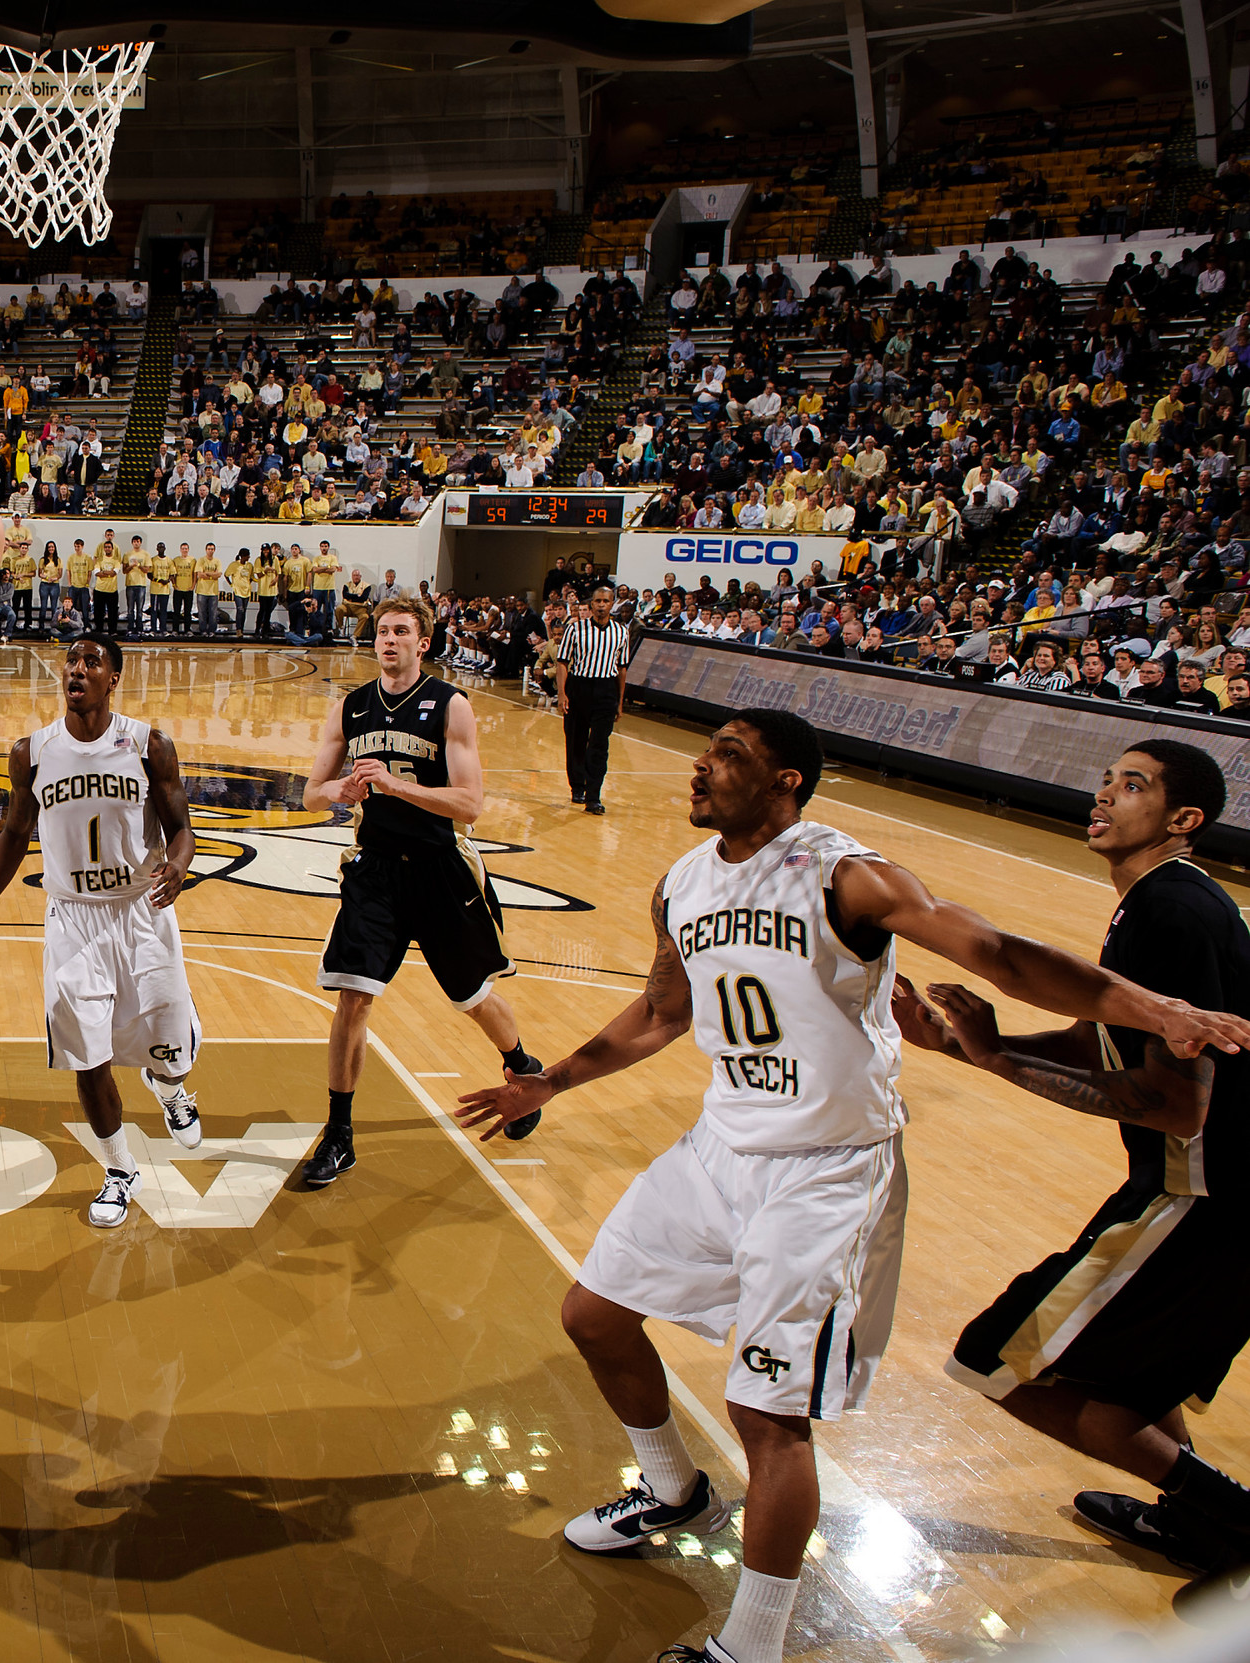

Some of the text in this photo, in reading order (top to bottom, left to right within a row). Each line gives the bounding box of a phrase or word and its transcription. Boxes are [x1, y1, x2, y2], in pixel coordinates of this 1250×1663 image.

[487, 508, 506, 522] 59
[528, 497, 568, 512] 12:34
[550, 512, 558, 523] 2
[586, 509, 607, 524] 29
[665, 538, 799, 565] GEICO
[961, 665, 975, 677] POSS
[726, 663, 797, 711] Iman
[797, 674, 962, 751] Shumpert
[348, 730, 438, 762] WAKE FOREST
[41, 773, 140, 811] GEORGIA
[88, 813, 101, 864] 1
[70, 865, 132, 894] TECH
[679, 908, 809, 963] GEORGIA
[714, 972, 783, 1048] 10
[149, 1043, 182, 1063] GT
[720, 1055, 799, 1097] TECH
[740, 1344, 791, 1384] GT
